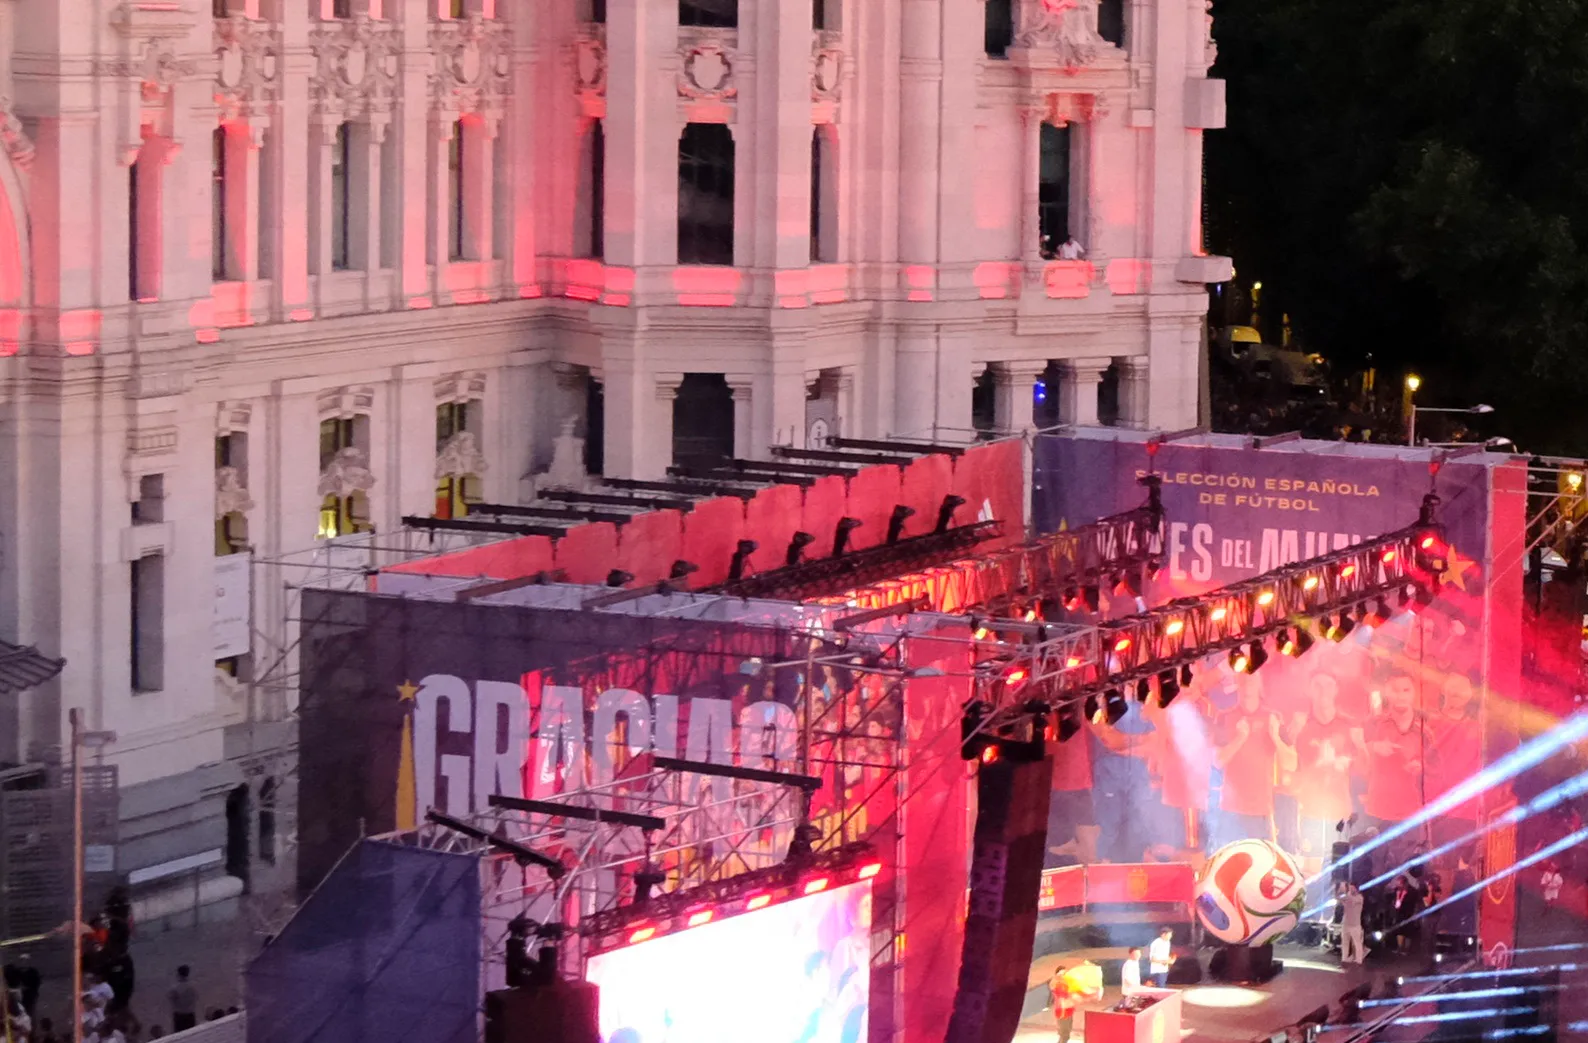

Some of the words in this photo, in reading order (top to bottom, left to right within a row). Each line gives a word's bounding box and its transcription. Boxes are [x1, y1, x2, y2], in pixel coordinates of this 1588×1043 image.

[1135, 470, 1256, 489] SLECCIÓN
[1264, 477, 1380, 497] ESPAÑOLA
[1200, 492, 1227, 505] DE
[1235, 492, 1320, 512] FÚTBOL
[1221, 538, 1254, 569] DEL
